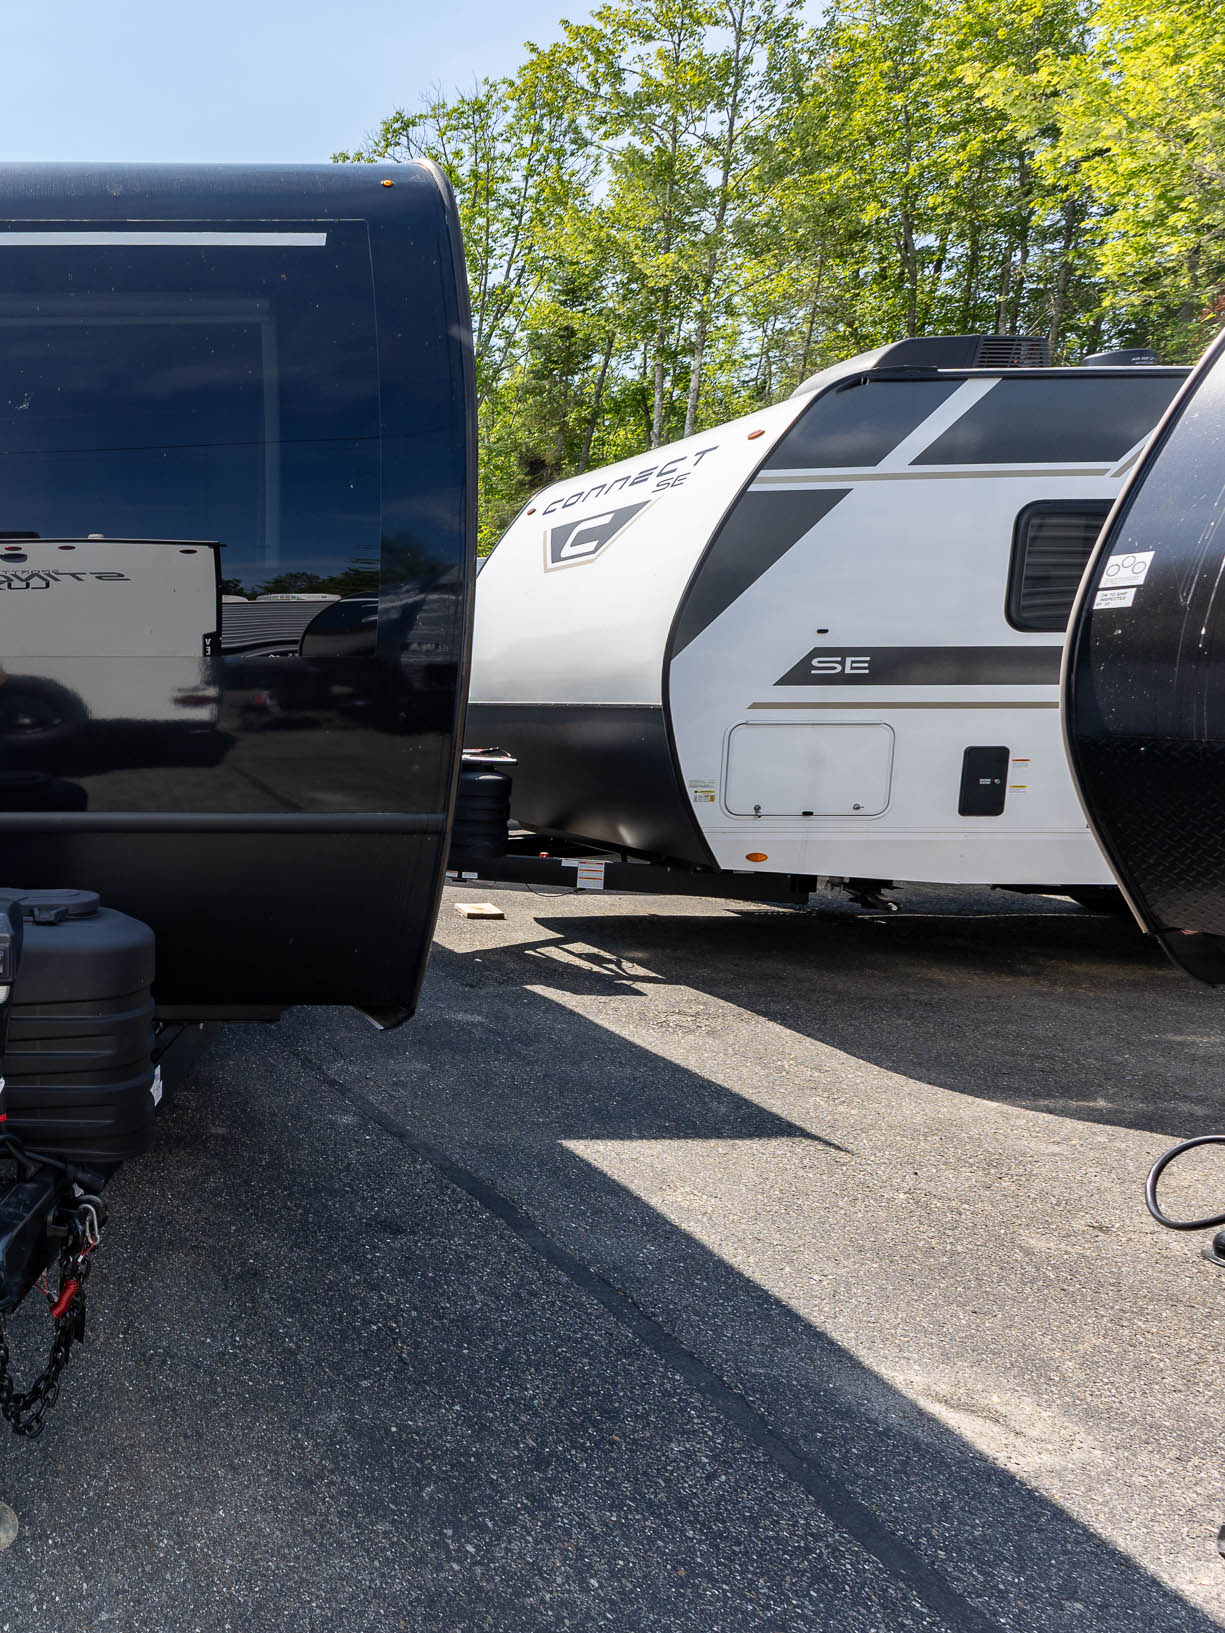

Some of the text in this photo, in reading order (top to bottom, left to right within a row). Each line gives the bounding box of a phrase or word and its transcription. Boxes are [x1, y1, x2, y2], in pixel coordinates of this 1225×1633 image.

[542, 445, 720, 516] CONNECT
[651, 472, 692, 494] SE
[560, 512, 616, 558] C
[810, 656, 871, 674] SE
